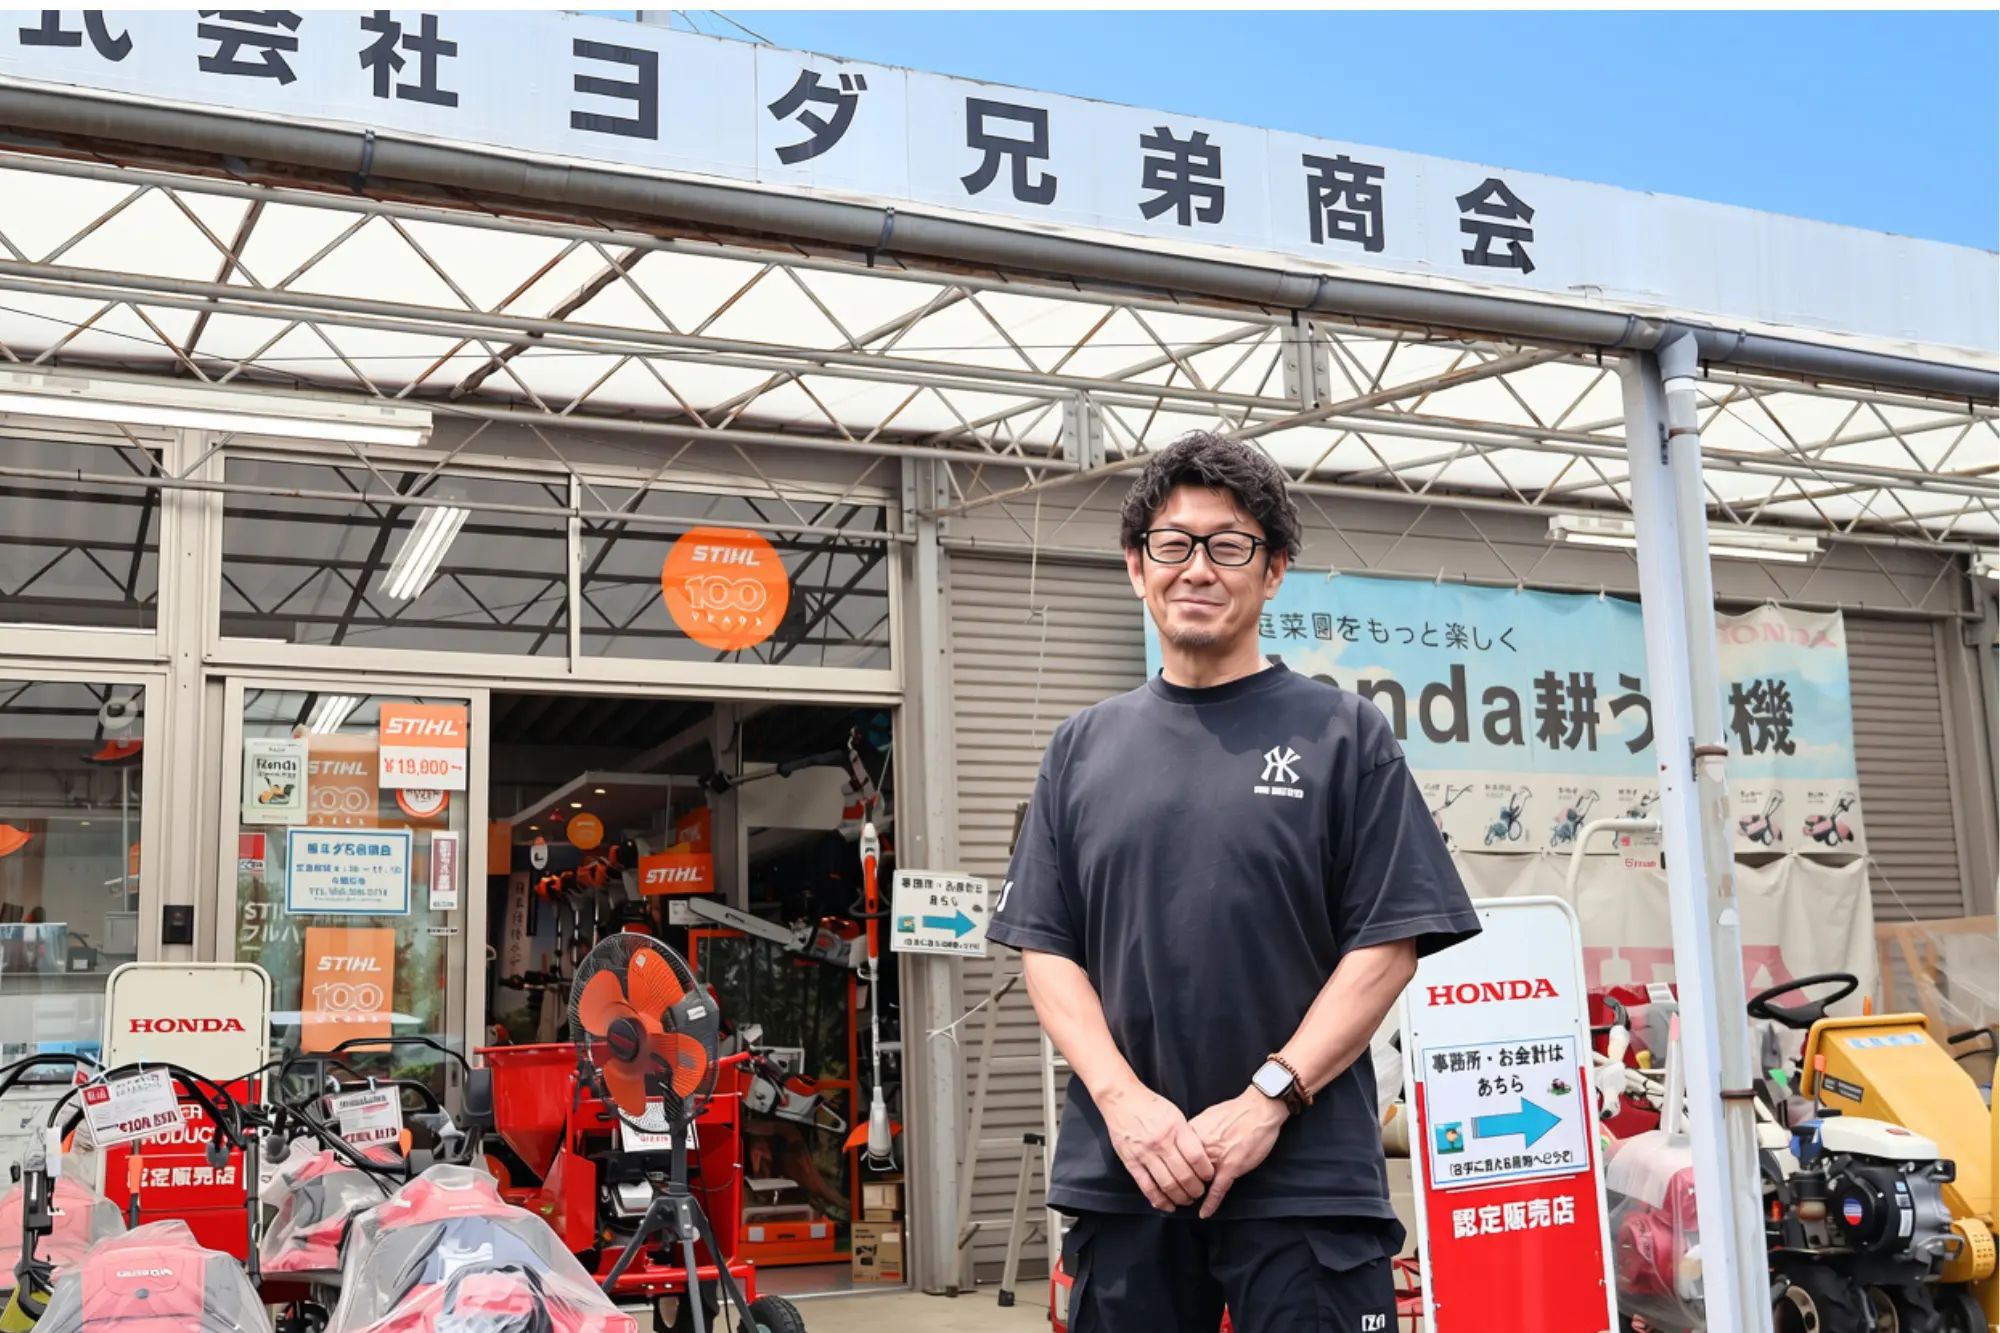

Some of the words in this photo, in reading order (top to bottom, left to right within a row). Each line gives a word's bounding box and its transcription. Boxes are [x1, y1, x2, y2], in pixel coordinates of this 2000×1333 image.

[692, 545, 760, 567] STIHL
[685, 575, 767, 612] 100
[385, 717, 458, 736] STIHL
[308, 760, 368, 775] STIHL
[645, 867, 703, 884] STIHL
[317, 956, 382, 971] STIHL
[312, 982, 384, 1013] 100
[1426, 978, 1559, 1007] HONDA
[129, 1018, 246, 1033] HONDA
[1452, 1194, 1575, 1239] 認定販売店
